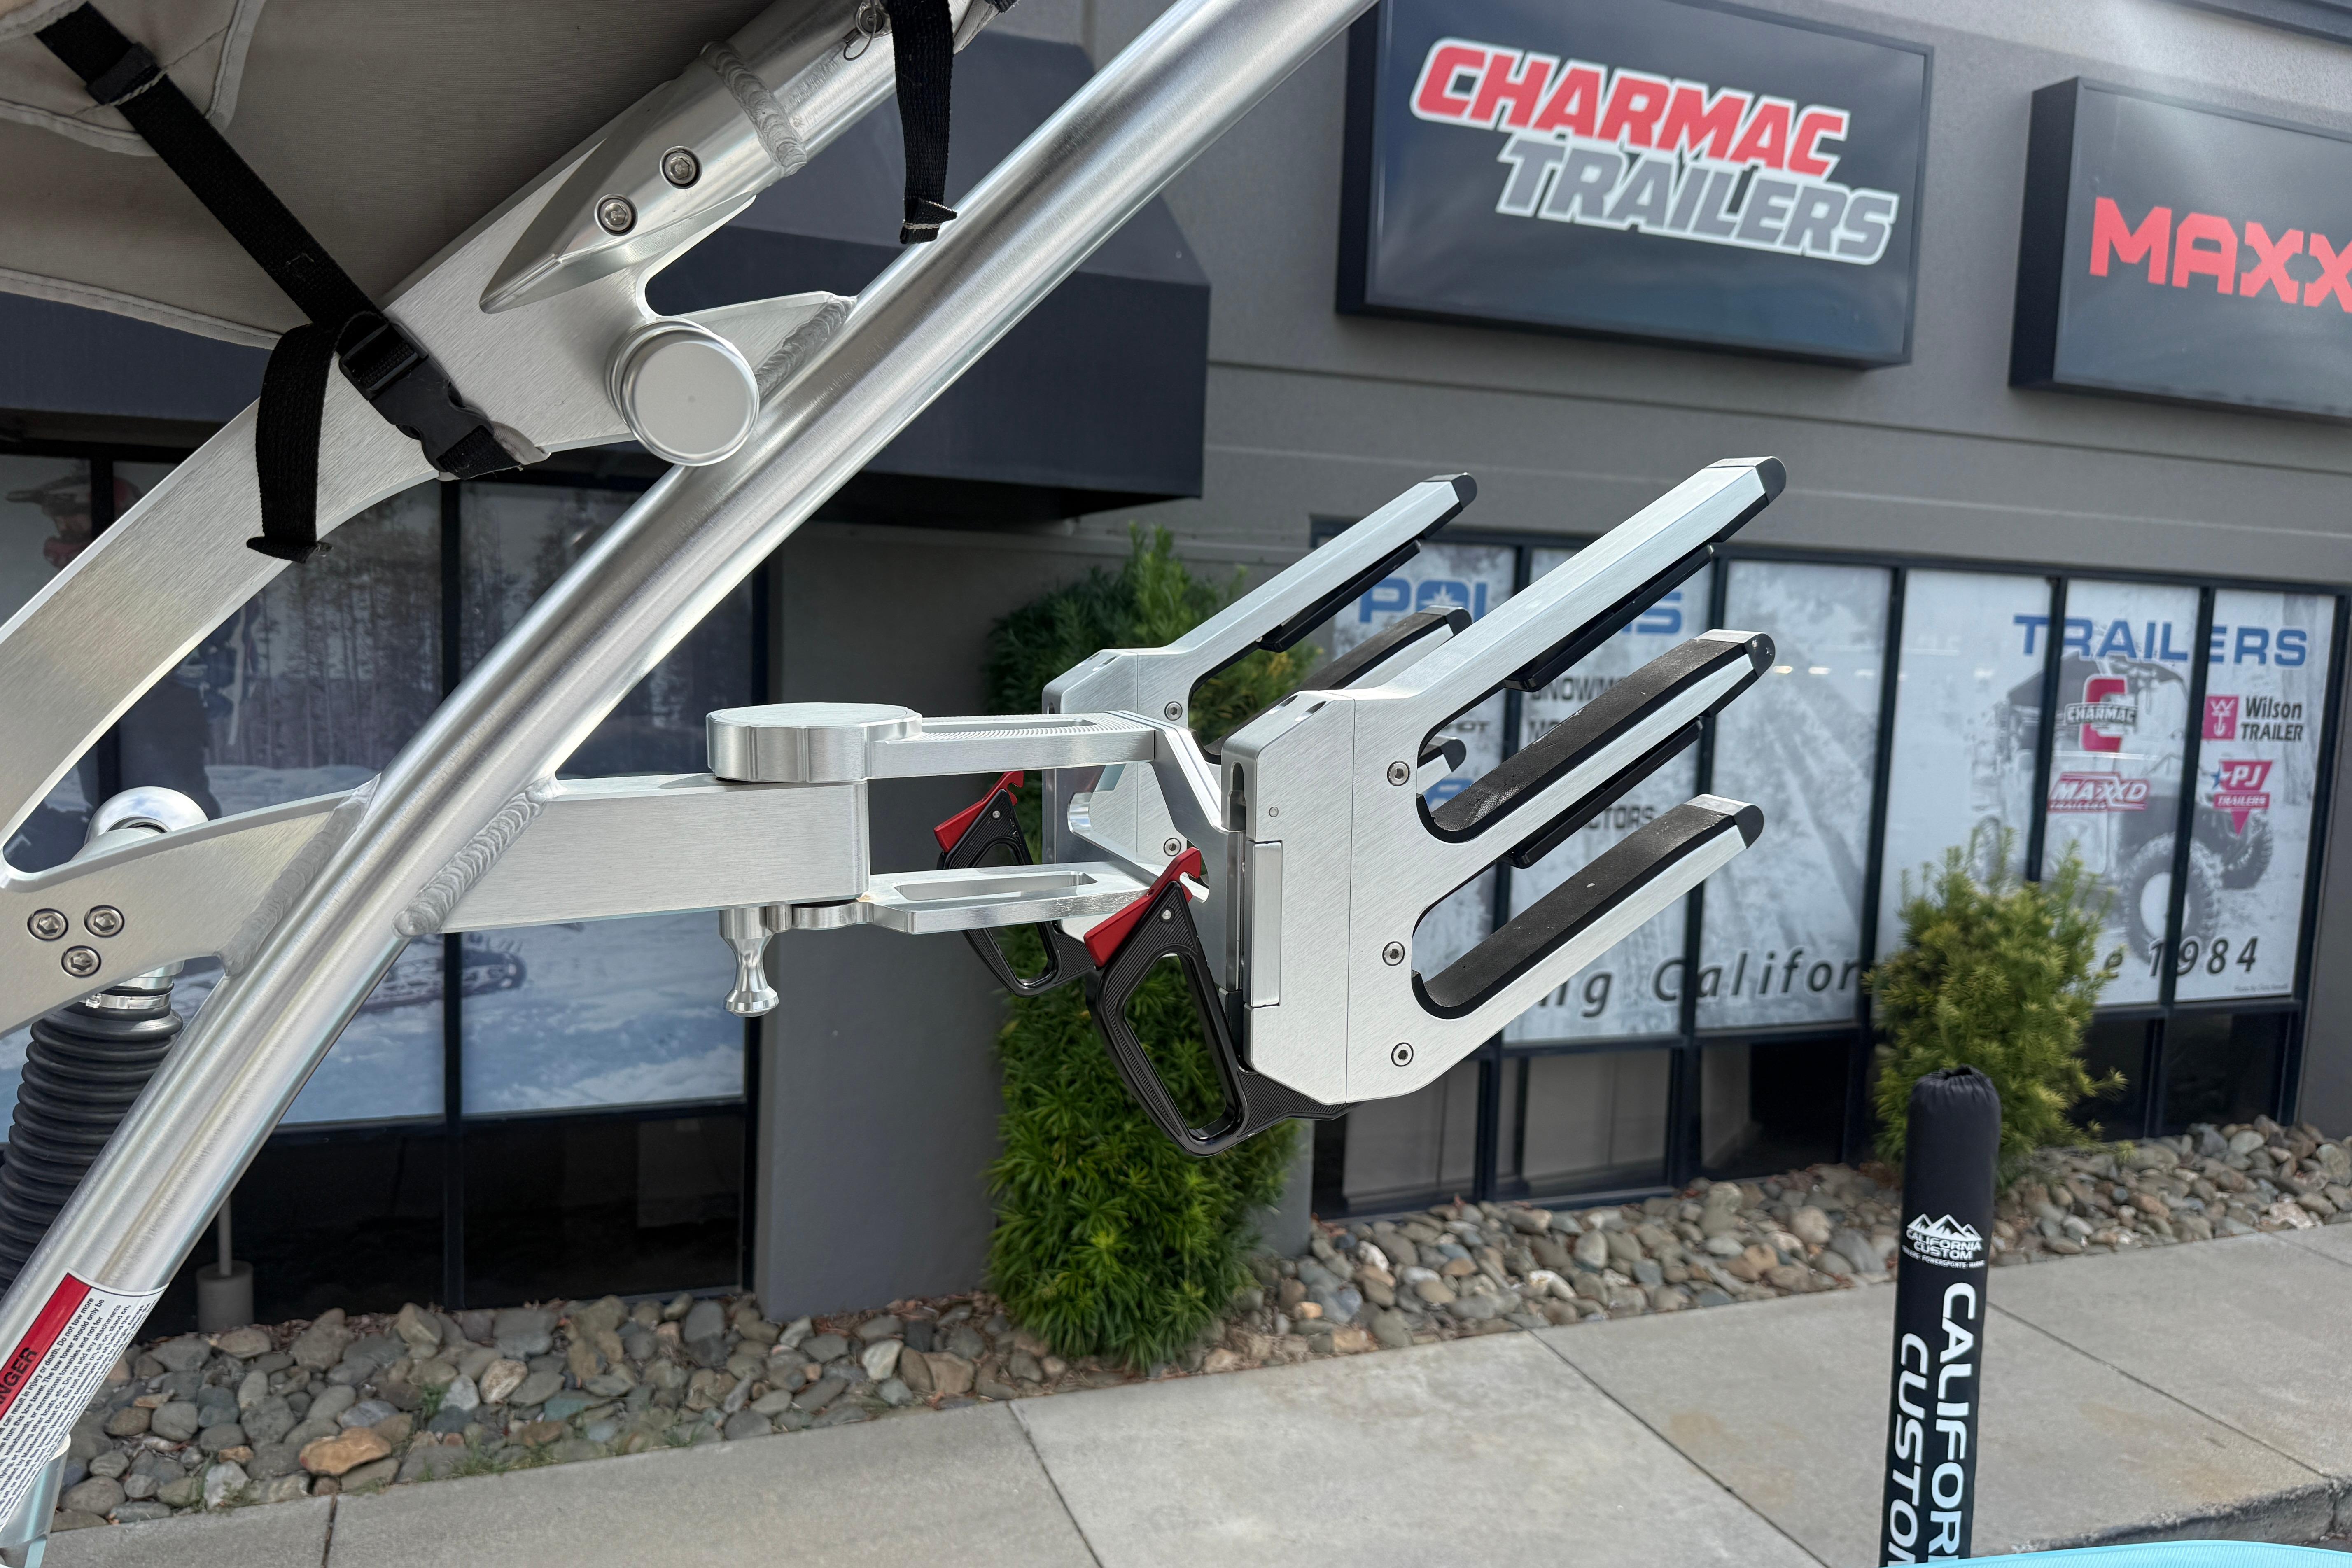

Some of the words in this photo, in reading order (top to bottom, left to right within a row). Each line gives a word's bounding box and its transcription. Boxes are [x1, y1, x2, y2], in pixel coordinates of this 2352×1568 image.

[1412, 38, 1849, 180] CHARMAC
[1496, 135, 1898, 264] TRAILERS
[2013, 615, 2307, 666] TRAILERS
[2066, 706, 2136, 723] CHARMAC
[2245, 695, 2302, 719] Wilson
[2241, 723, 2303, 740] TRAILER
[2229, 765, 2263, 787] PJ
[2053, 777, 2148, 801] MAXXD
[2218, 795, 2266, 806] TRAILERS
[1654, 948, 1860, 1001] Califor
[2149, 936, 2258, 977] 1984
[1906, 1229, 1983, 1251] CALIFORNIA
[1913, 1240, 1973, 1260] CUSTOM
[2, 1415, 13, 1426] can
[11, 1397, 26, 1414] result
[26, 1373, 42, 1390] injury
[44, 1348, 60, 1365] death.
[56, 1337, 67, 1346] Do
[64, 1326, 75, 1337] not
[71, 1314, 82, 1325] tow
[80, 1298, 94, 1314] more
[2, 1427, 16, 1440] from
[13, 1415, 25, 1426] this
[21, 1402, 33, 1414] tow
[29, 1384, 46, 1402] tower.
[42, 1372, 54, 1382] The
[51, 1359, 62, 1371] tow
[59, 1342, 74, 1358] tower
[72, 1321, 89, 1341] should
[87, 1307, 99, 1320] only
[1927, 1282, 1976, 1562] CALIFOR
